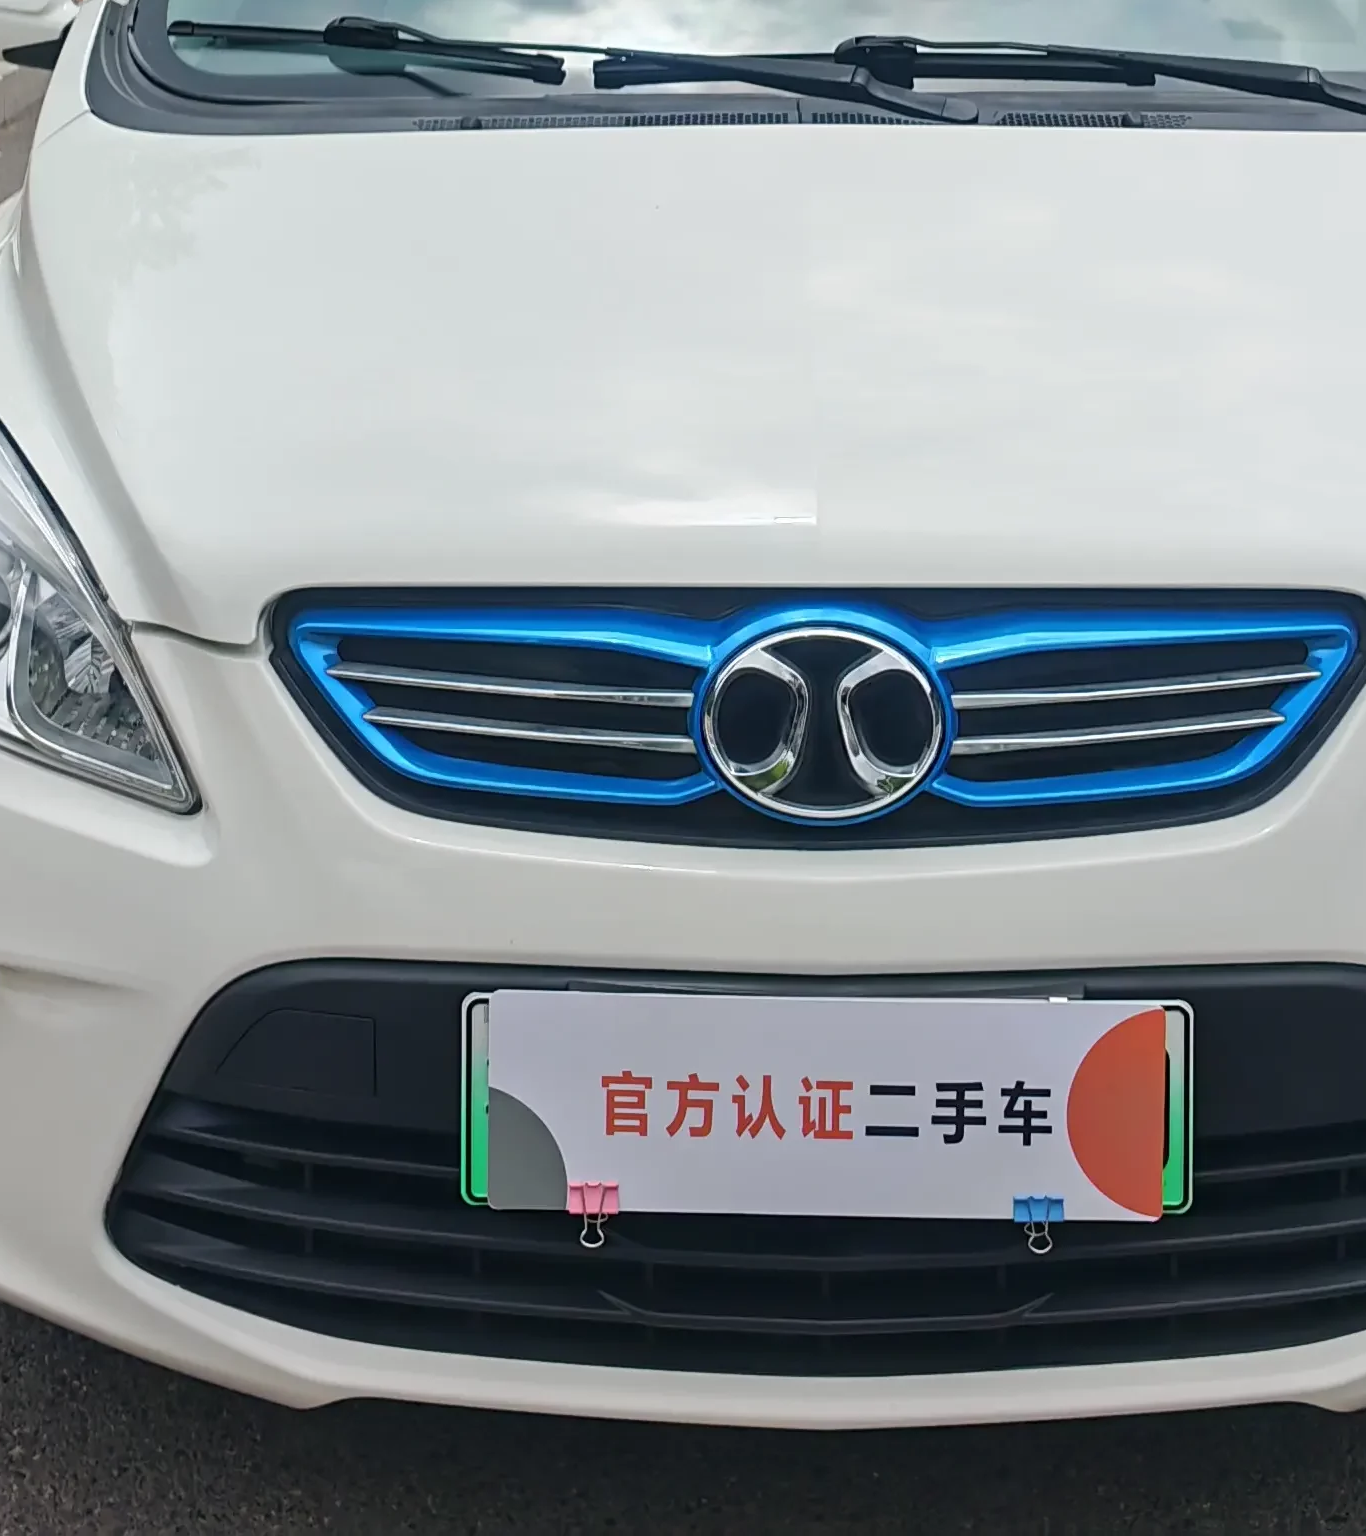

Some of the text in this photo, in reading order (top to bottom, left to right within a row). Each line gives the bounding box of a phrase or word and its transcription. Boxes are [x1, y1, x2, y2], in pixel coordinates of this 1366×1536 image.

[601, 1070, 1053, 1147] 官方认证二手车
